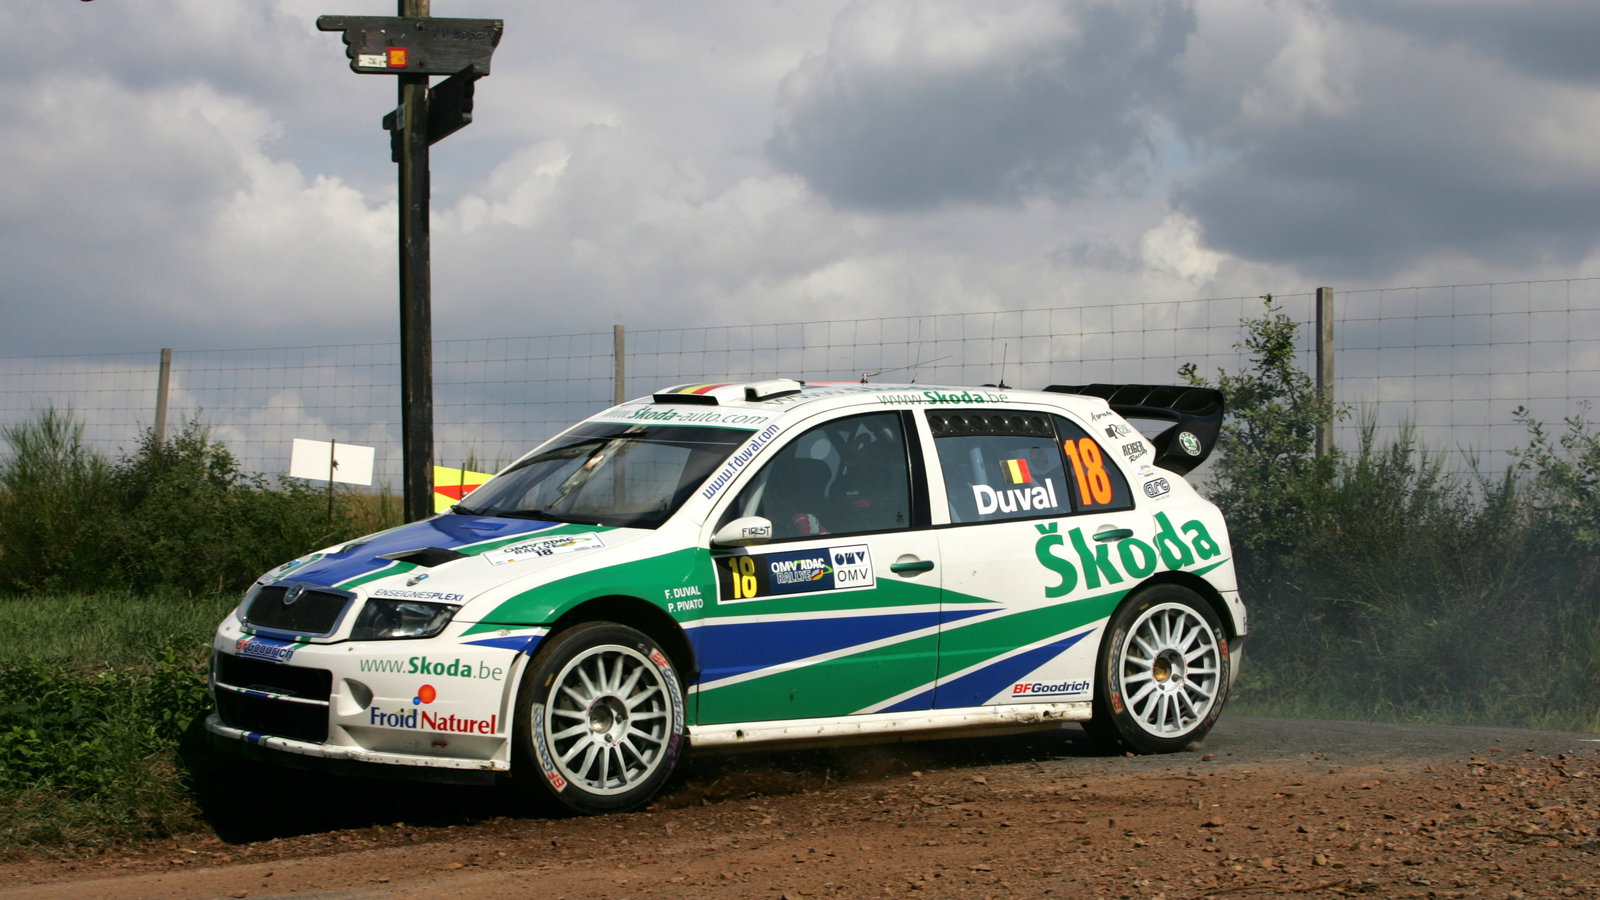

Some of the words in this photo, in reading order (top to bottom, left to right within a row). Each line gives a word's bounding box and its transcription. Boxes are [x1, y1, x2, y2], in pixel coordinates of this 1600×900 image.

[876, 390, 1009, 405] www.Skoda.be
[1121, 441, 1146, 457] REIGER
[702, 424, 780, 500] www.fduval.com
[1063, 437, 1113, 506] 18
[972, 478, 1058, 515] Duval
[741, 526, 770, 538] FIRST
[535, 549, 554, 557] 18
[1034, 511, 1222, 598] Škoda
[771, 560, 797, 573] OMV
[800, 558, 825, 570] ADAC
[728, 556, 758, 598] 18
[777, 569, 813, 584] RALLYE
[837, 568, 868, 583] OMV
[664, 590, 673, 599] F.
[673, 586, 702, 598] DUVAL
[668, 602, 676, 613] P.
[677, 599, 704, 611] PIVATO
[360, 656, 503, 681] www.Skoda.be
[1013, 680, 1090, 694] BFGoodrich
[370, 706, 418, 729] Froid
[421, 711, 497, 735] Naturel
